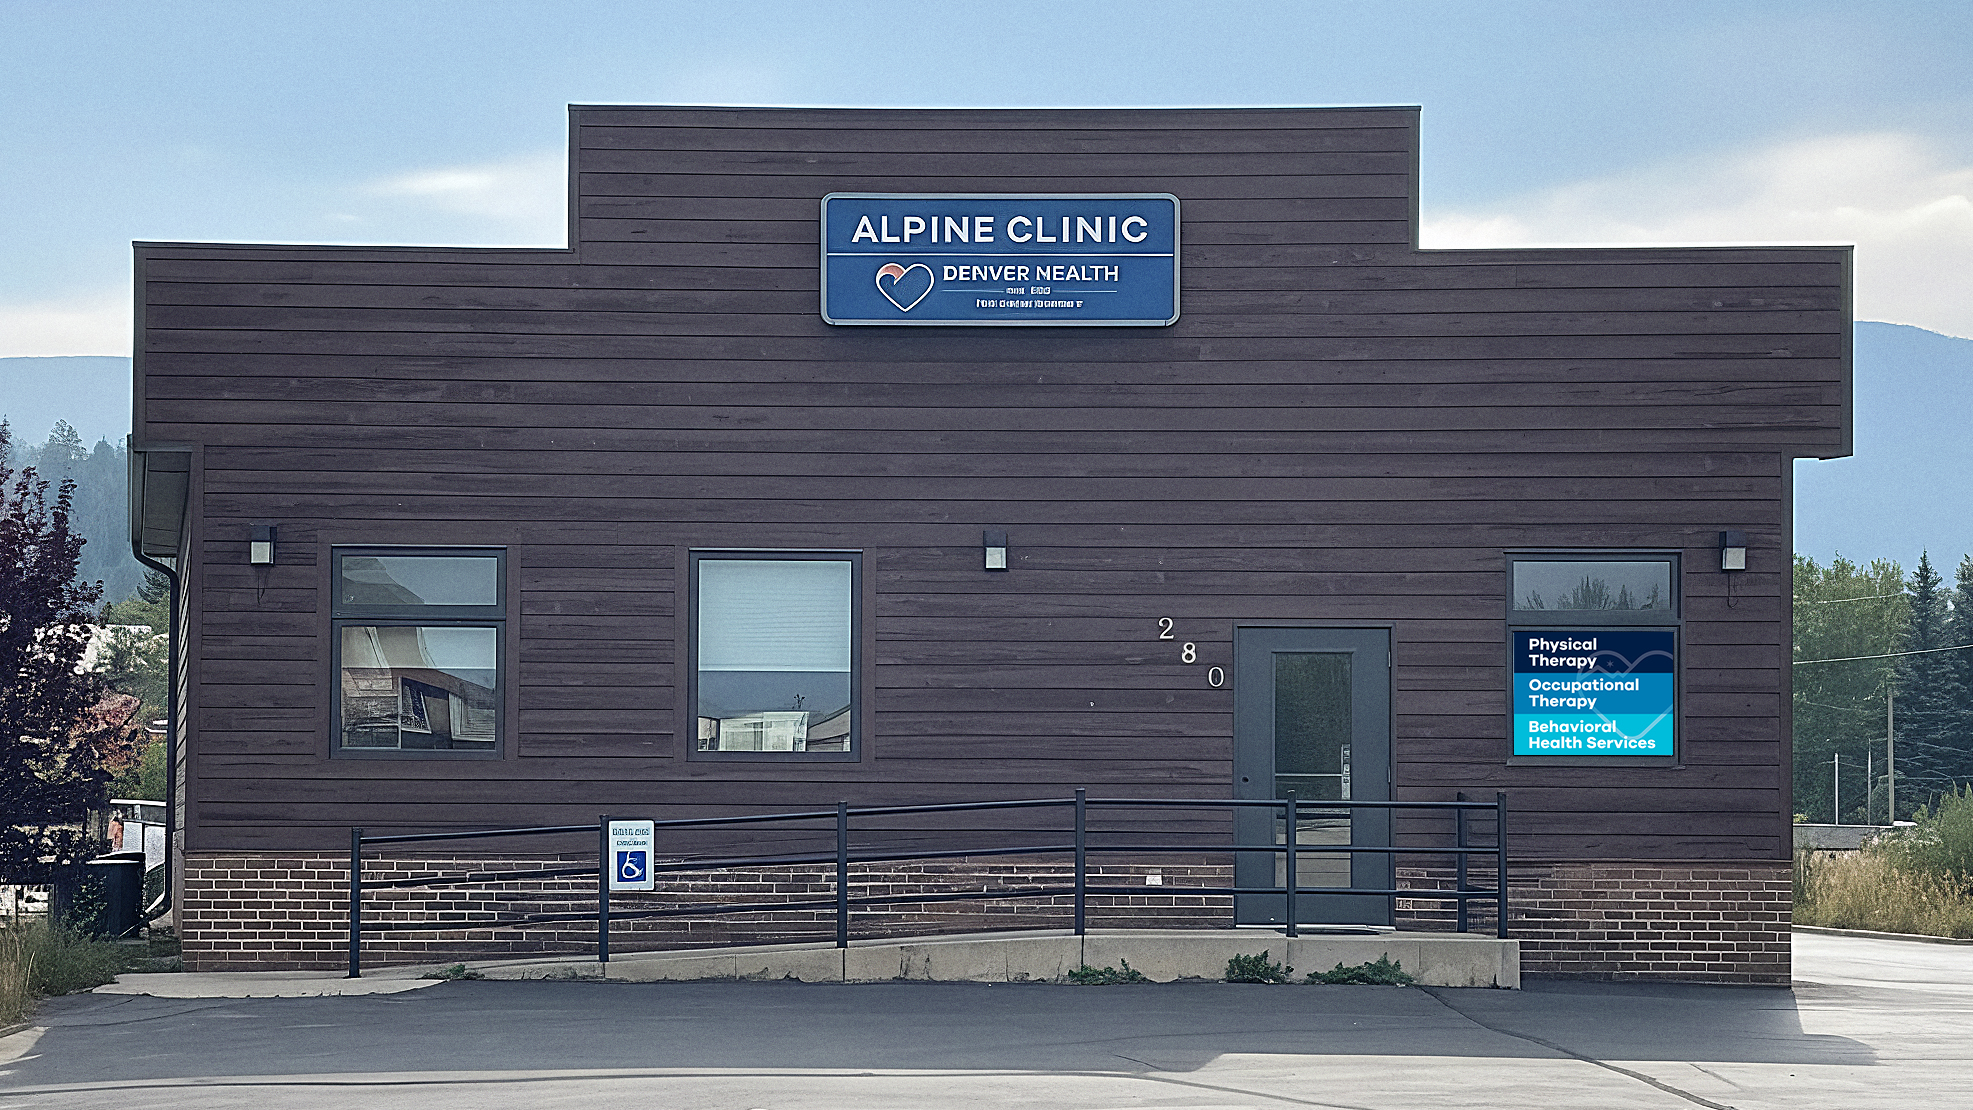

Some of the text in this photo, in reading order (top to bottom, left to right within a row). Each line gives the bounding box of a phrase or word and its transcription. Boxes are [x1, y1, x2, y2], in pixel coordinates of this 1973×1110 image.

[851, 215, 1149, 243] ALPINE CLINIC
[943, 265, 1030, 282] DENVER
[1528, 637, 1597, 653] Physical
[1528, 653, 1597, 669] Therapy
[1528, 678, 1639, 693] Occupational
[1528, 693, 1597, 709] Therapy
[1528, 720, 1617, 733] Behavioral
[1528, 736, 1656, 749] Health Services
